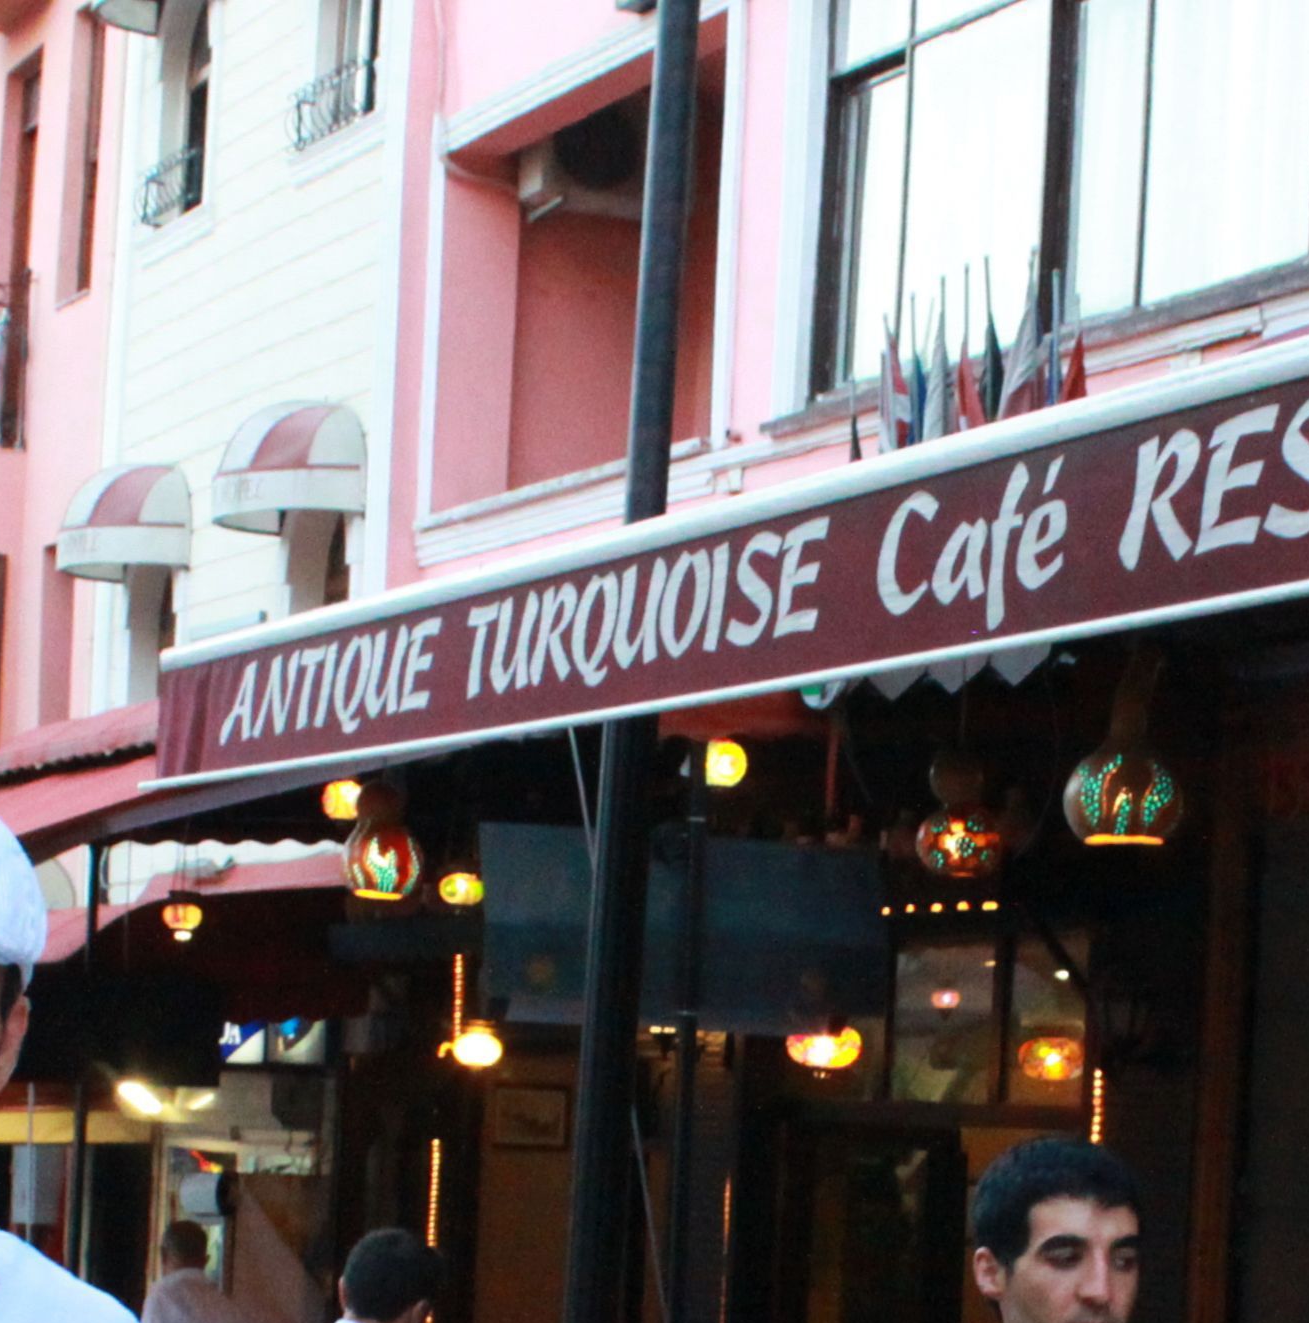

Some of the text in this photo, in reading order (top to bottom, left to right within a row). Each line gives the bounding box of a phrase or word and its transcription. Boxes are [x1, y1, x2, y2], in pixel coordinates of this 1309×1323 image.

[219, 615, 441, 746] ANTIQUE
[466, 515, 831, 701] TURQUOISE
[877, 454, 1070, 631] Café
